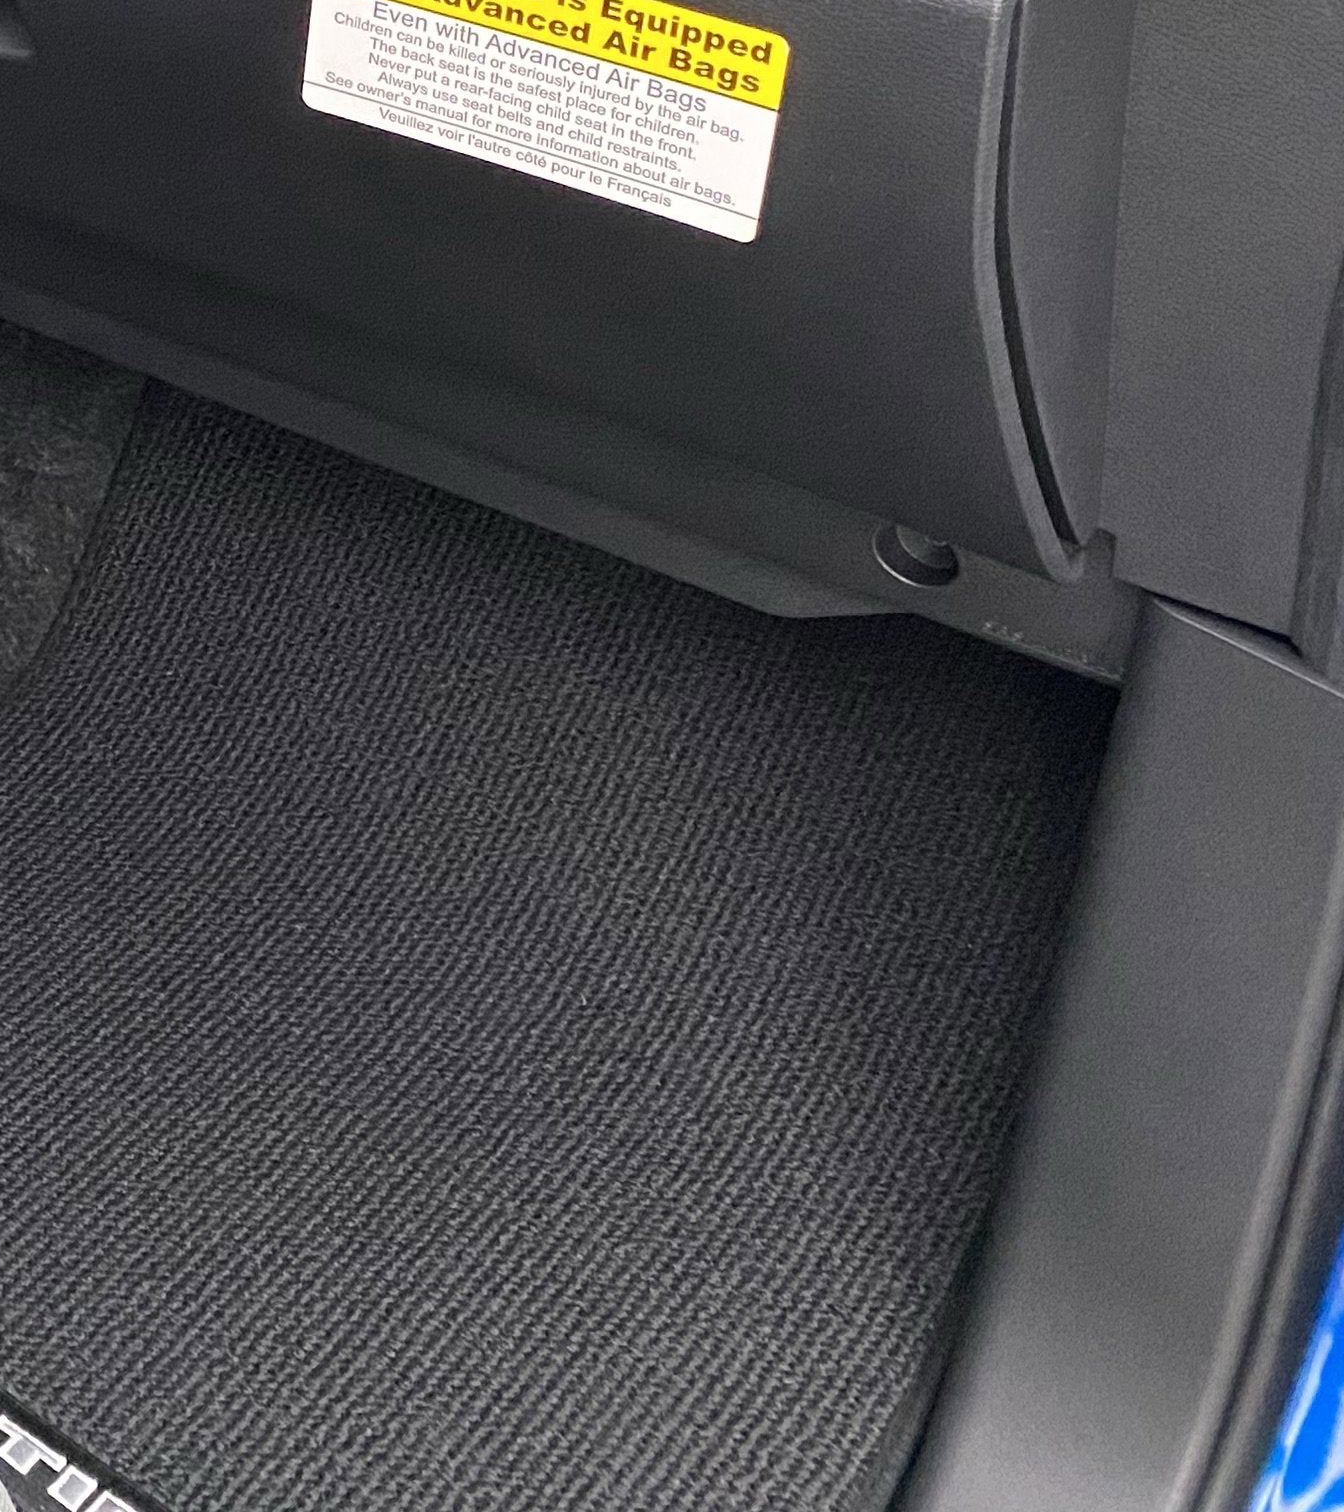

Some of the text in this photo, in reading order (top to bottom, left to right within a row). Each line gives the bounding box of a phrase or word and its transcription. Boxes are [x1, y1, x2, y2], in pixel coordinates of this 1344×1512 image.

[334, 11, 744, 143] Children can be killed or seriously injured by the air bag.
[368, 52, 696, 161] Never put a rear-facing child seat in the front.
[370, 36, 699, 145] The back seat is the safest place for children.
[373, 1, 707, 112] Even with Advanced Air Bags
[602, 31, 657, 62] Air
[669, 47, 760, 92] Bags
[325, 71, 736, 206] See owner's manual for more information about air bags.
[378, 71, 682, 172] Always use seat belts and child restraints.
[379, 106, 672, 207] Veuillez voir l'autre côté pour le Français
